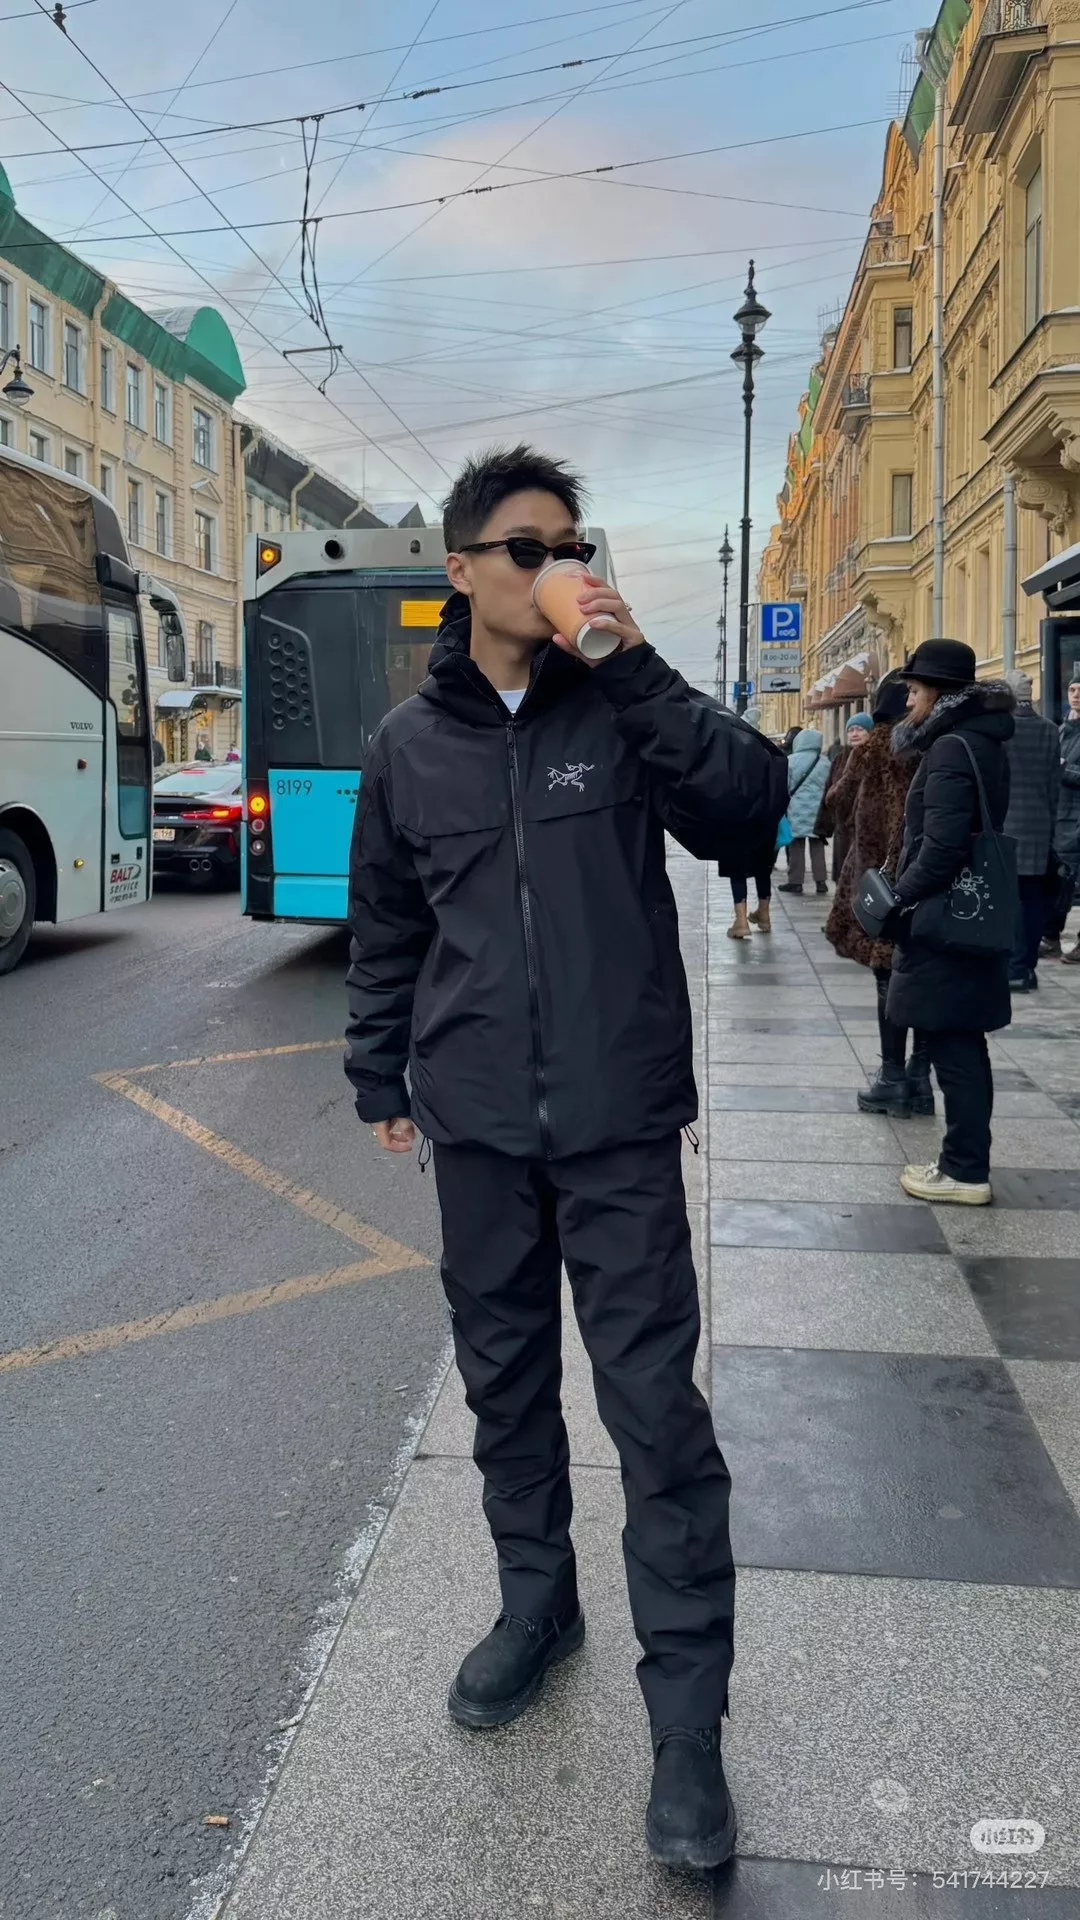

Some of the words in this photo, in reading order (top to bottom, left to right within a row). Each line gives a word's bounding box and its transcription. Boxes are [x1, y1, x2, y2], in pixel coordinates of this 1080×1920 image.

[772, 607, 794, 638] P
[70, 721, 94, 730] VOLVO
[276, 779, 312, 796] 8199
[110, 866, 134, 883] BALT
